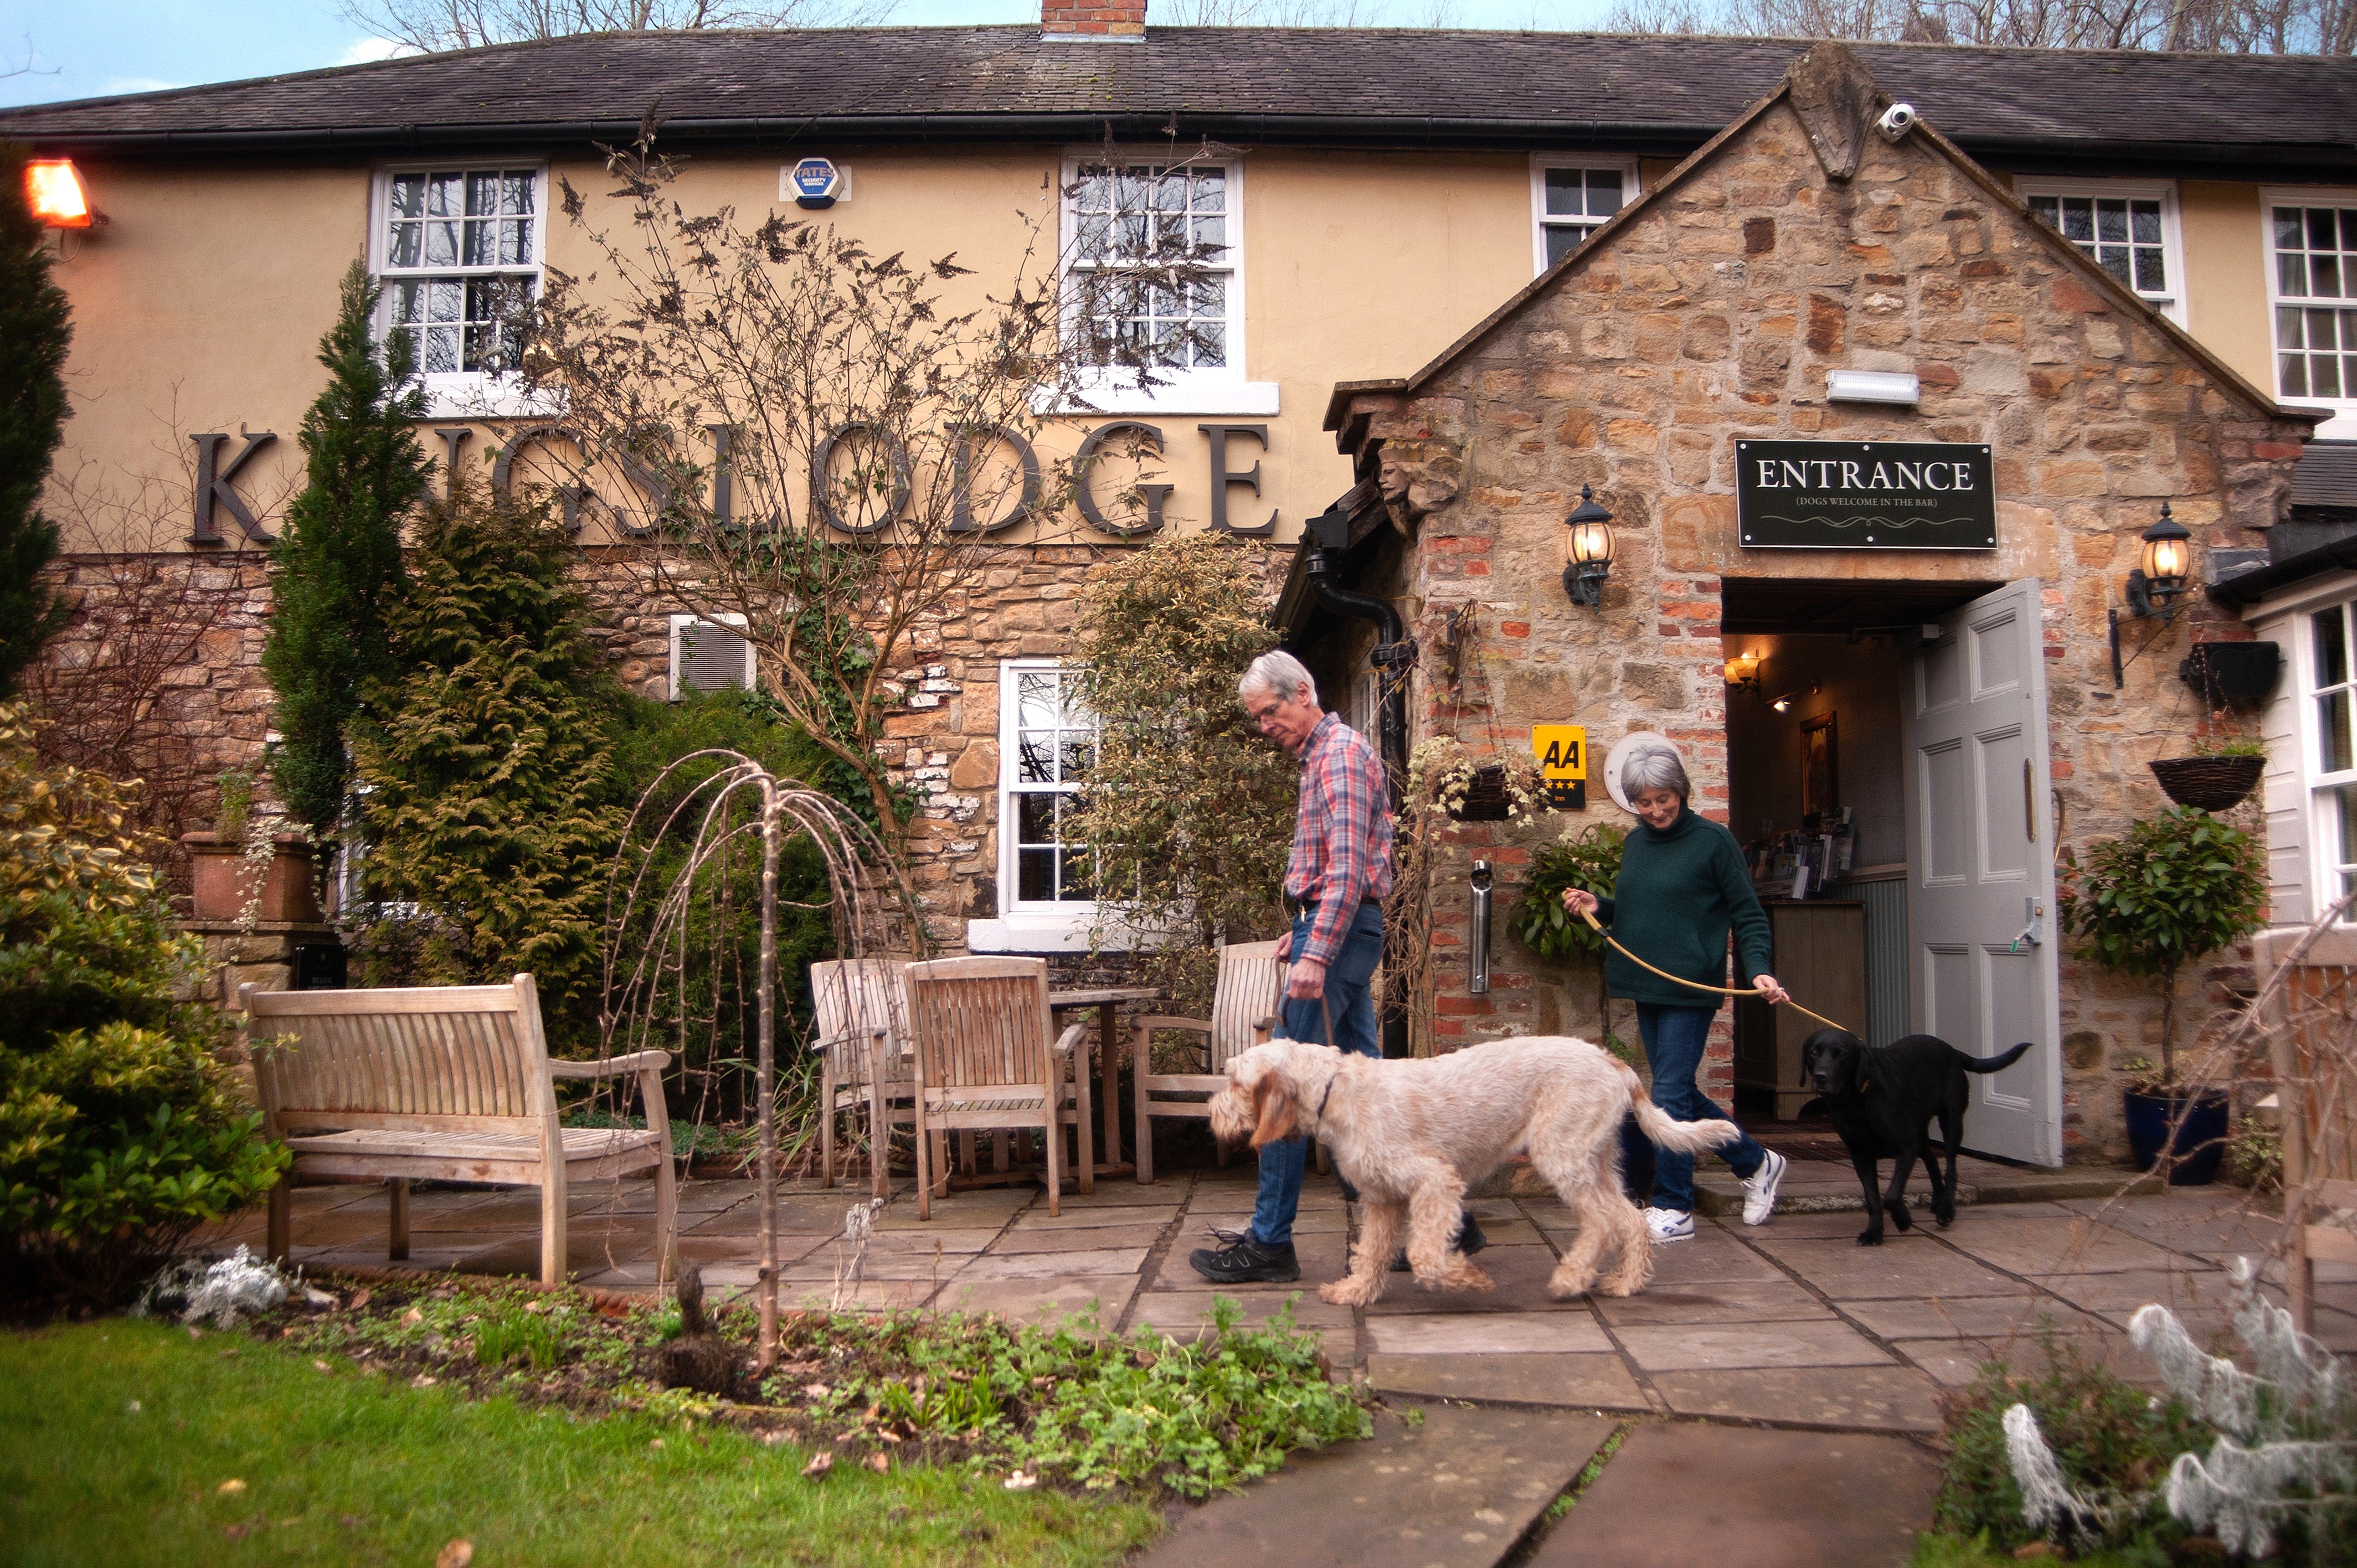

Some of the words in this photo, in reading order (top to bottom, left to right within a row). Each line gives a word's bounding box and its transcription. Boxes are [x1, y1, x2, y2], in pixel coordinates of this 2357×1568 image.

[795, 167, 835, 178] TATES
[184, 420, 1278, 545] KGSLODGE
[1756, 460, 1974, 491] ENTRANCE
[1796, 496, 1827, 507] (DOGS
[1829, 497, 1879, 506] WELCOME
[1915, 498, 1938, 508] BAR)
[1543, 741, 1579, 768] AA
